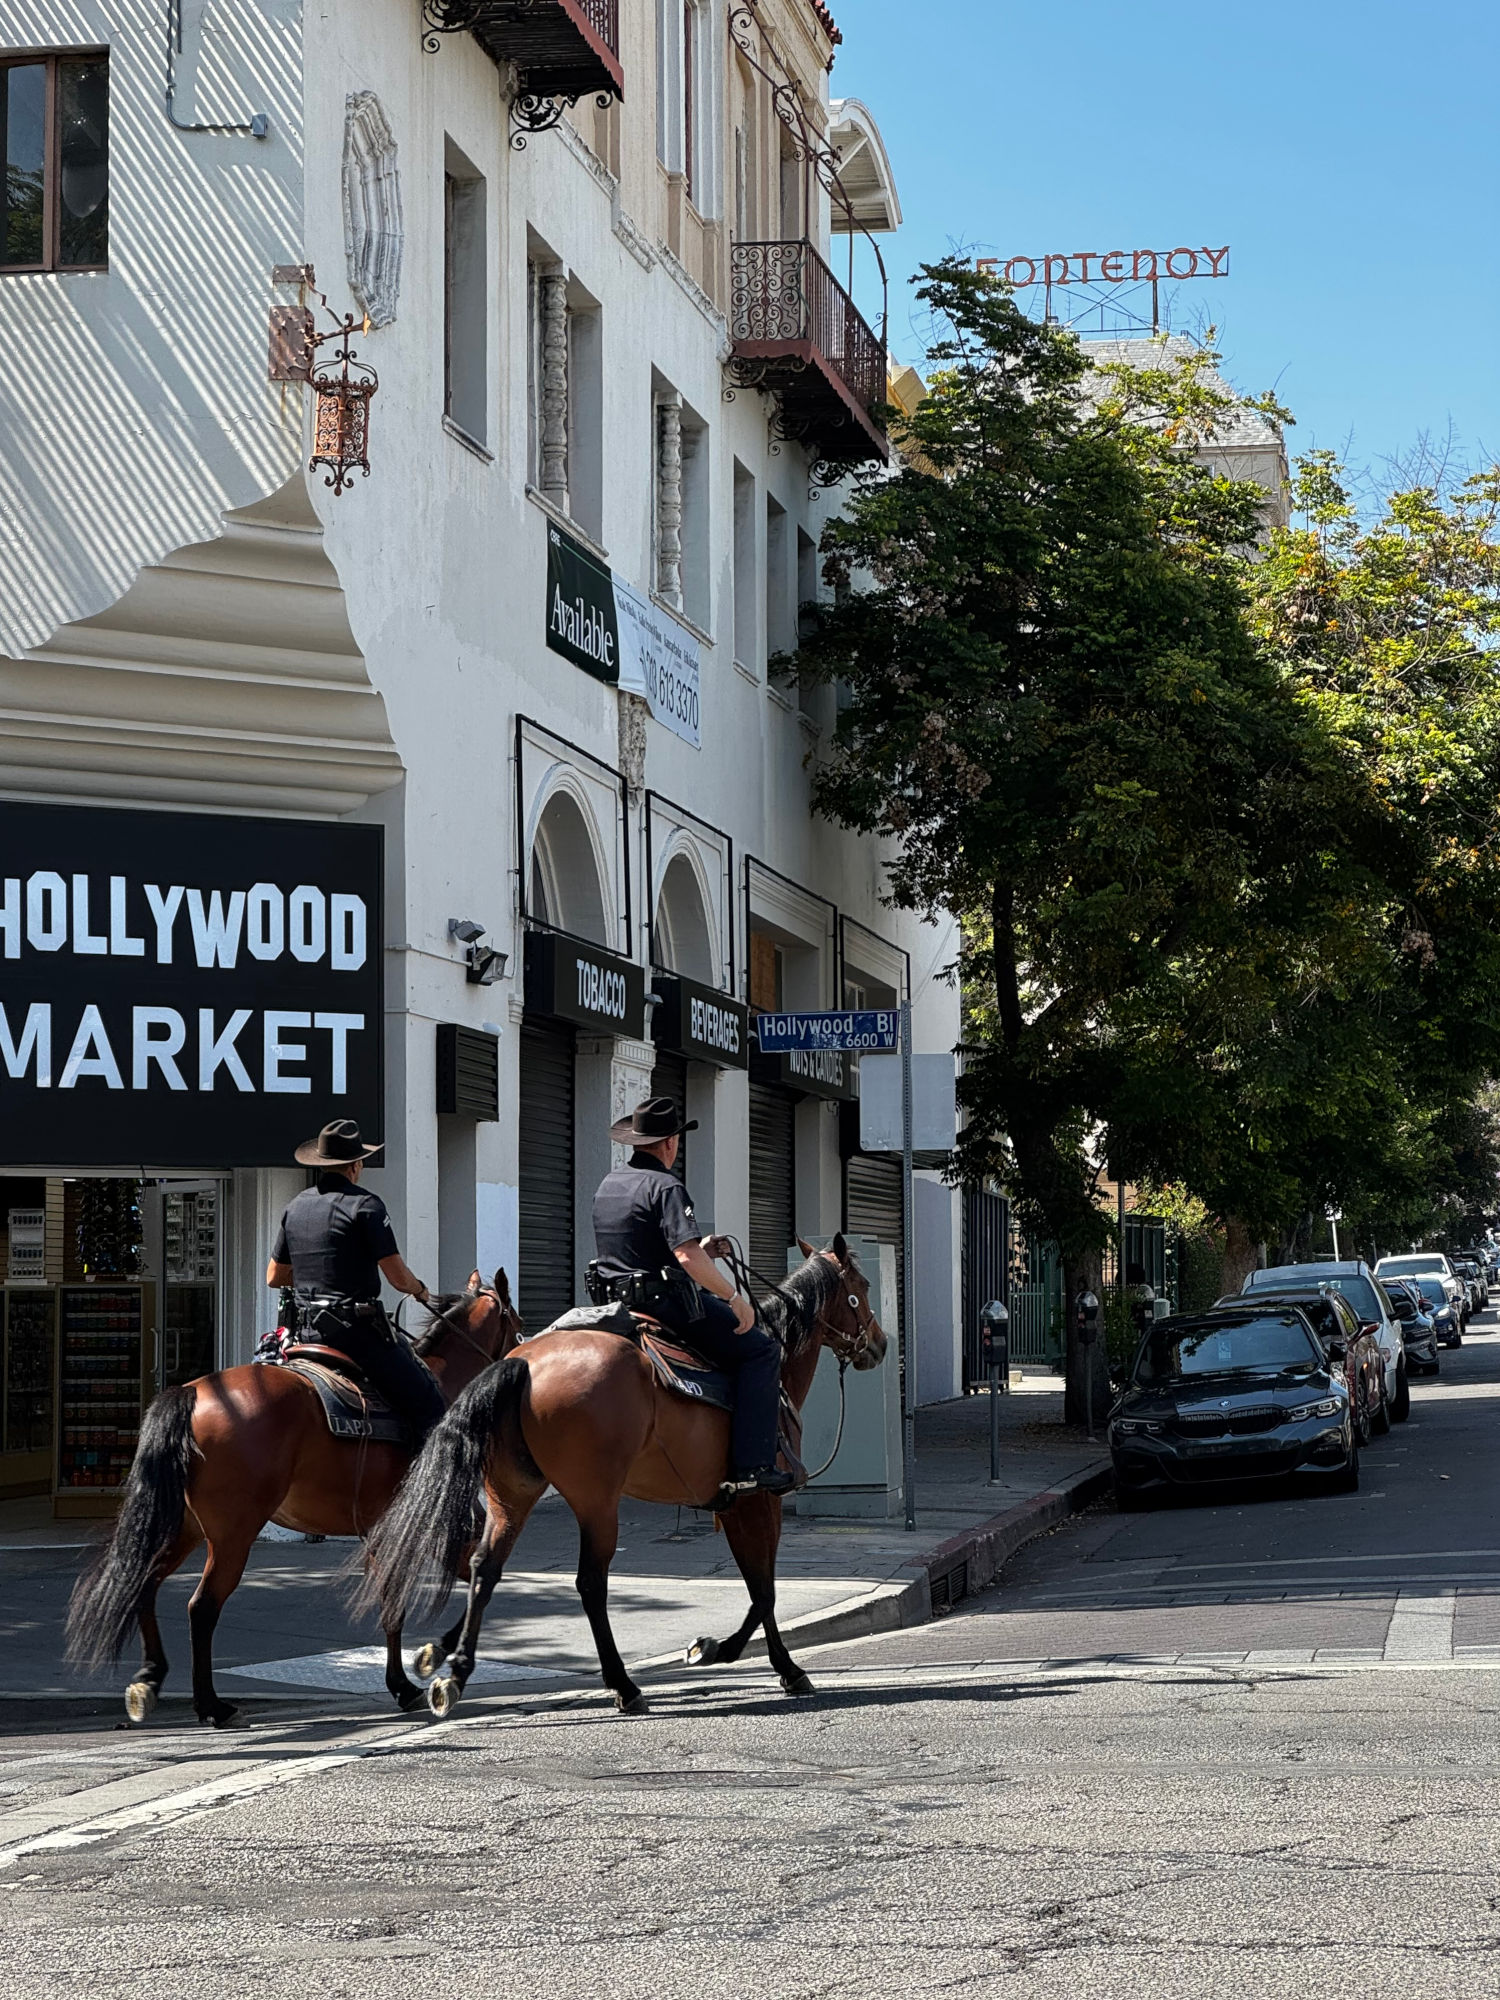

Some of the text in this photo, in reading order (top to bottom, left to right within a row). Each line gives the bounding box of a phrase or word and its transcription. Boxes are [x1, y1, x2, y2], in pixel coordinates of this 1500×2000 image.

[550, 583, 614, 667] Available
[659, 665, 674, 713] 613
[676, 679, 699, 730] 3370
[576, 959, 626, 1020] TOBACCO
[0, 1002, 365, 1094] MARKET
[690, 997, 740, 1054] BEVERAGES
[764, 1013, 894, 1040] Hollywood Bl
[846, 1033, 894, 1047] 6600 W
[334, 1416, 373, 1436] LAPD
